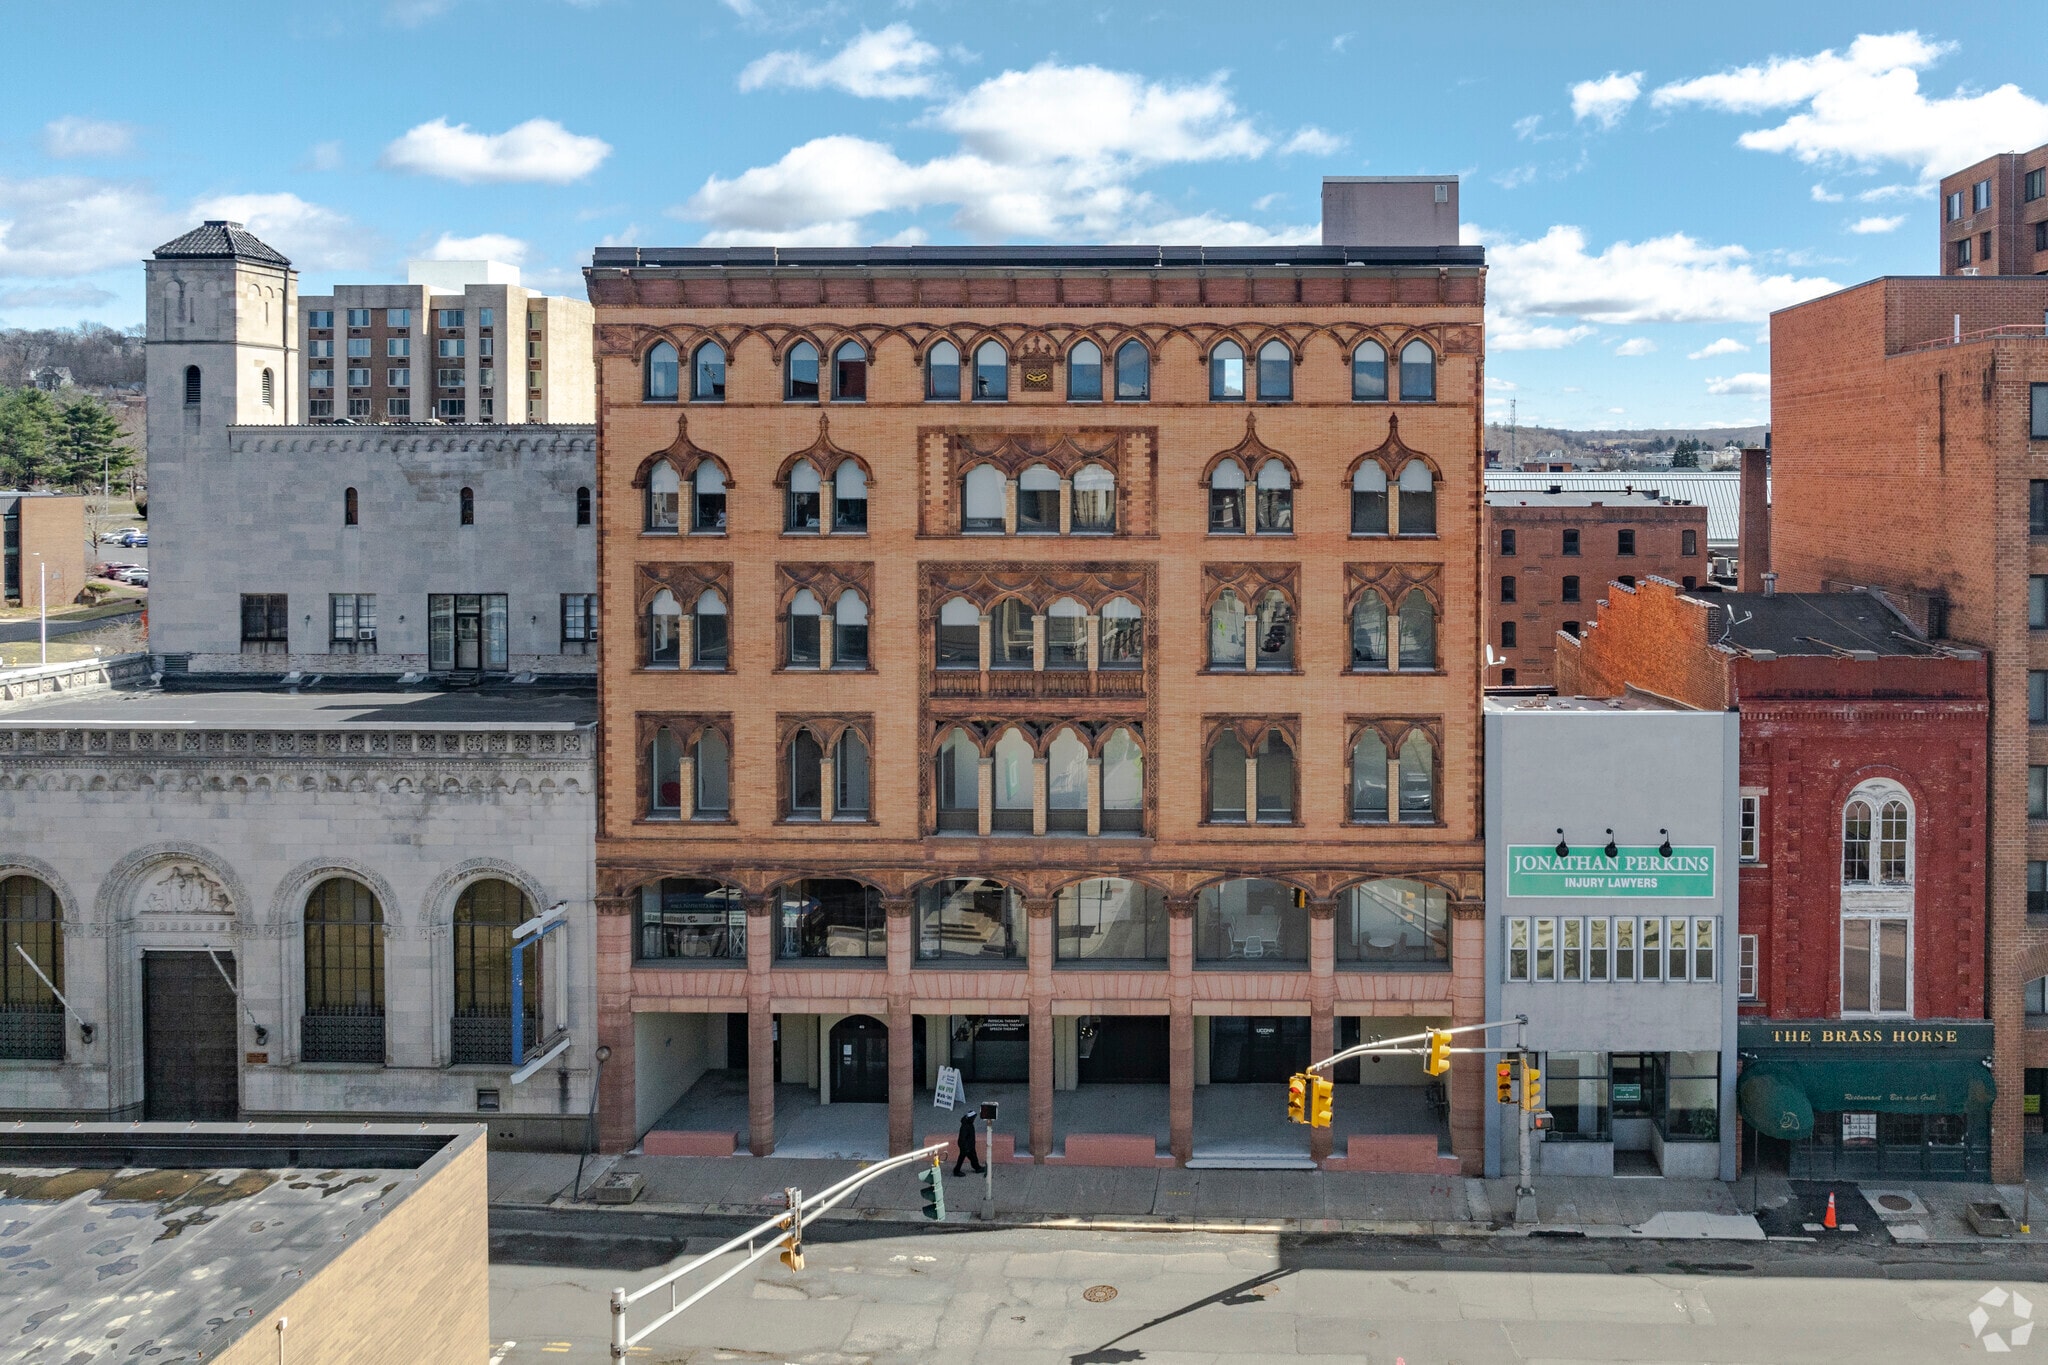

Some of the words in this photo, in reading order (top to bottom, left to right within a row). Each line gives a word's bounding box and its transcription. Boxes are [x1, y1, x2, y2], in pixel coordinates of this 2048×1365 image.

[1514, 855, 1619, 874] JONATHAN
[1624, 855, 1709, 872] PERKINS
[1565, 877, 1605, 888] INJURY
[1608, 877, 1658, 888] LAWYERS
[1771, 1030, 1811, 1042] THE
[1821, 1030, 1883, 1042] BRASS
[1892, 1030, 1958, 1042] HORSE
[1844, 1093, 1882, 1101] Restaurant
